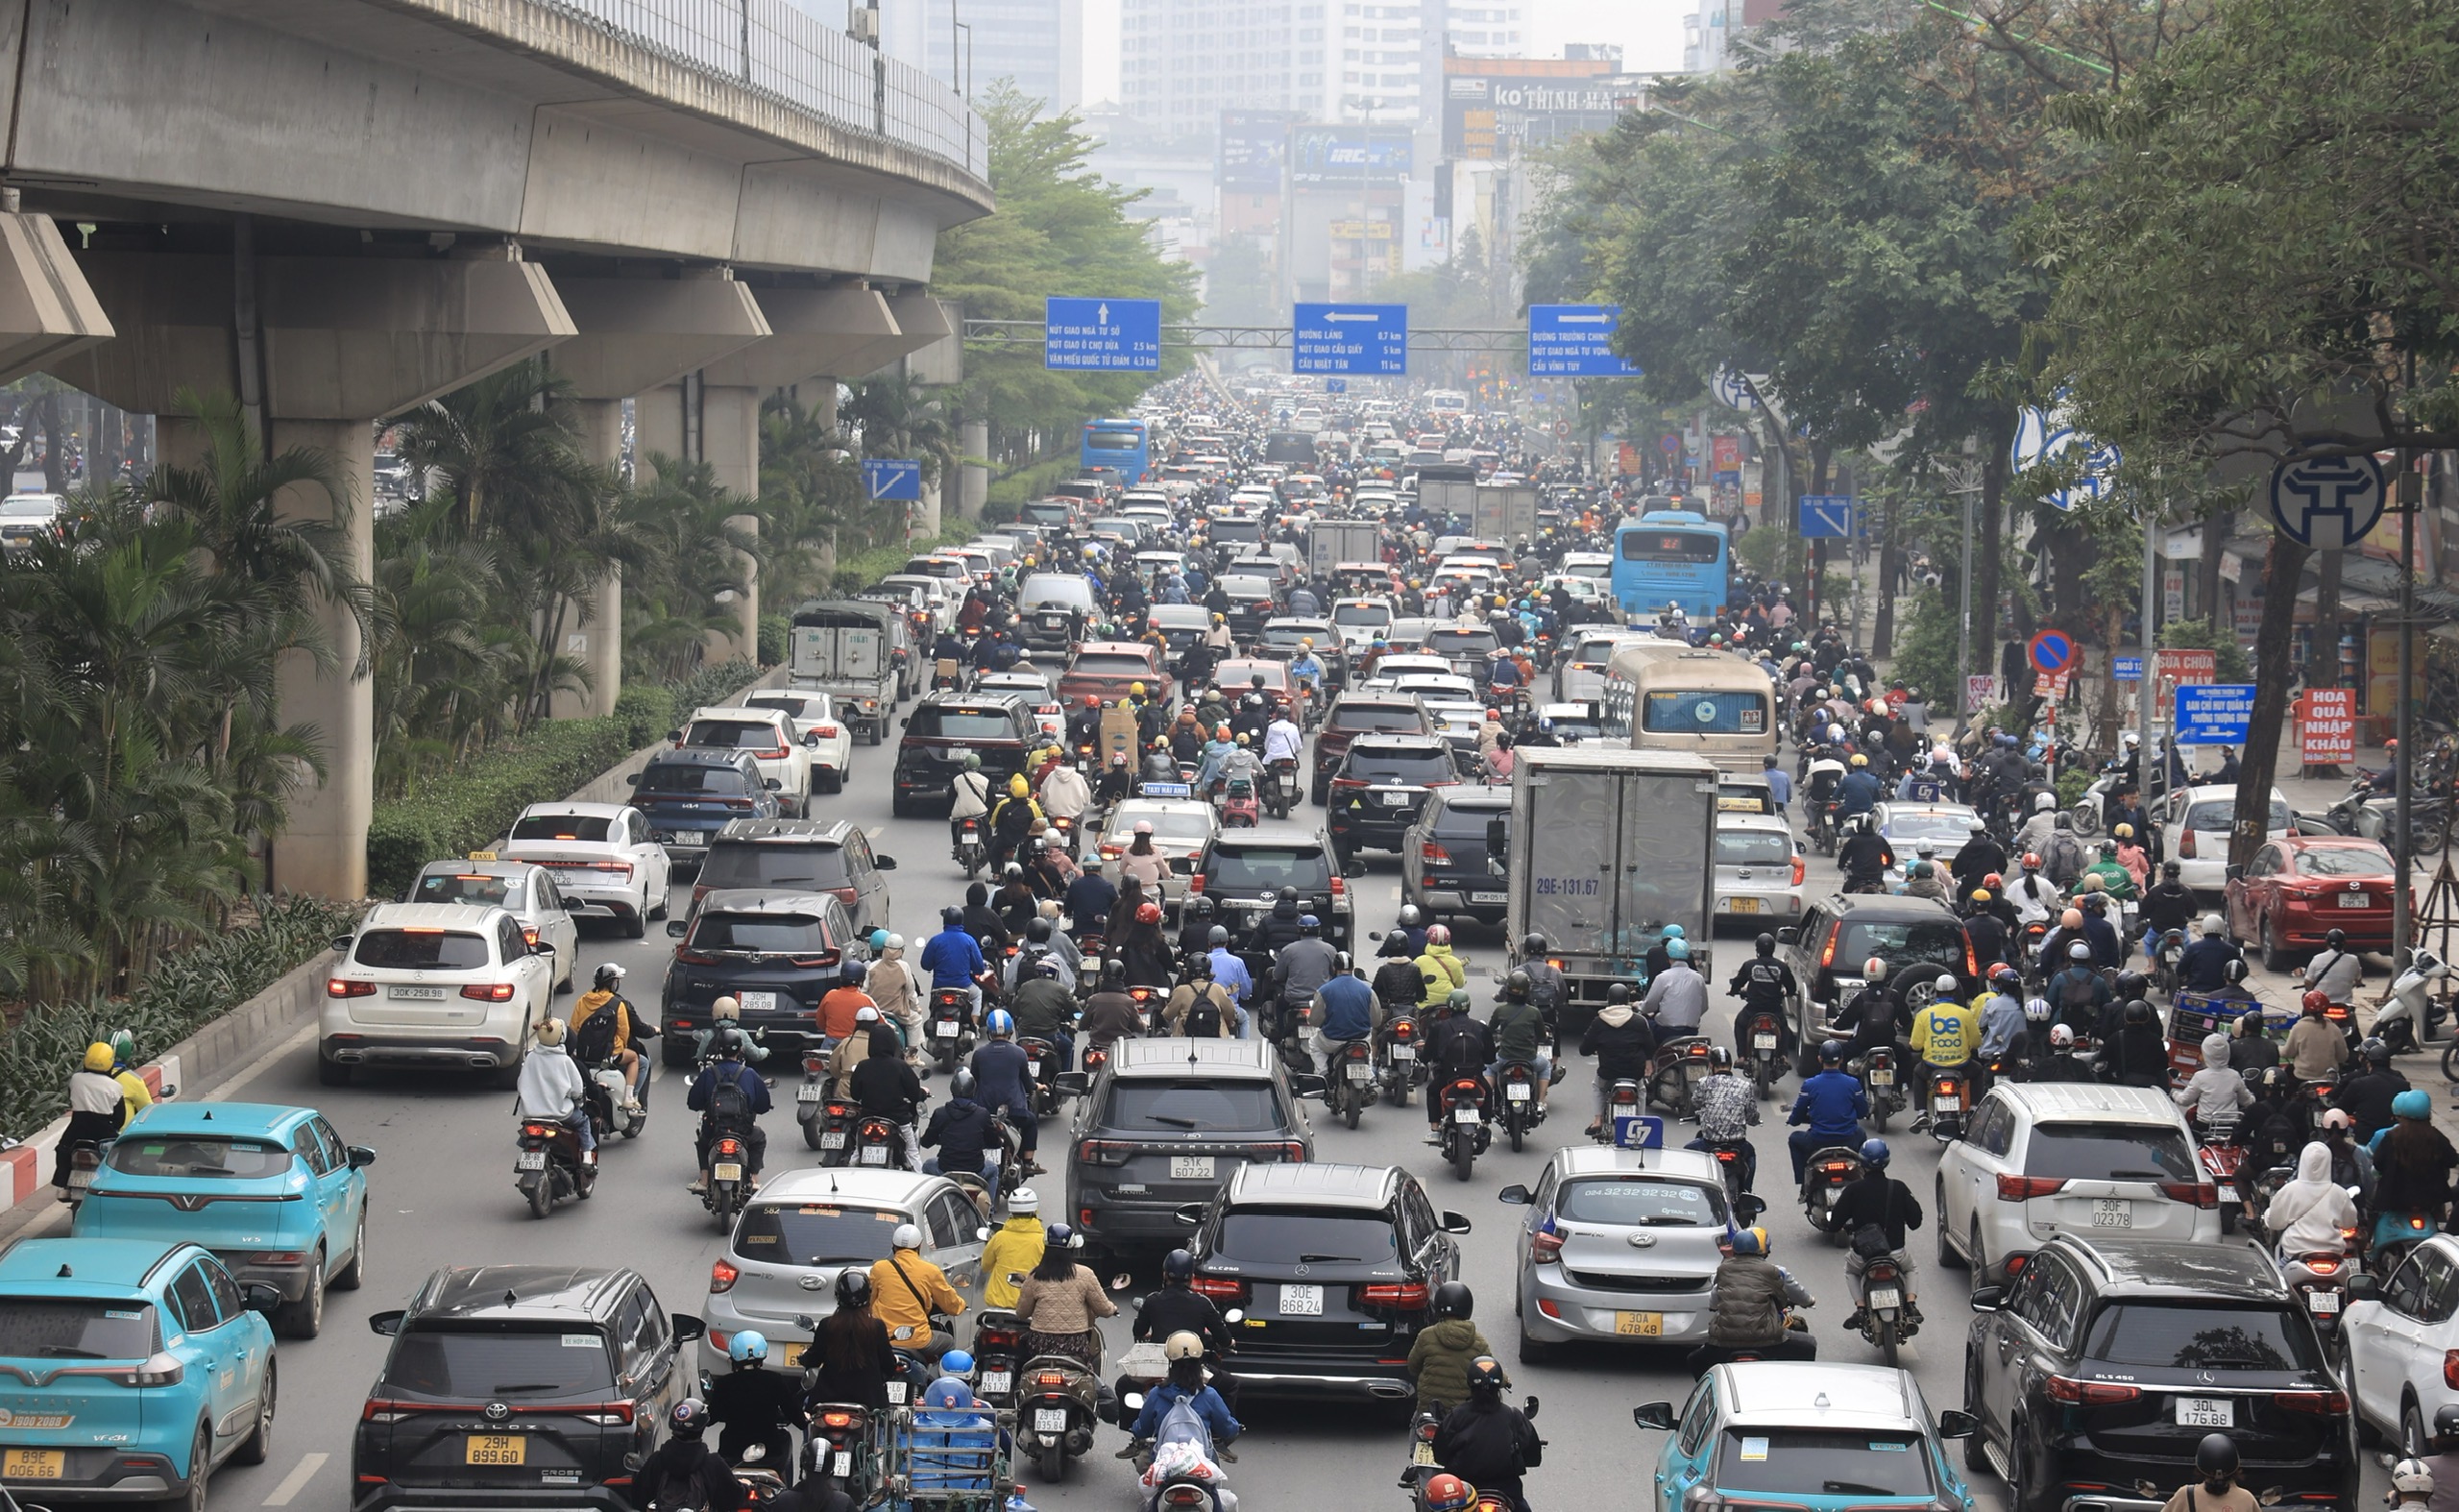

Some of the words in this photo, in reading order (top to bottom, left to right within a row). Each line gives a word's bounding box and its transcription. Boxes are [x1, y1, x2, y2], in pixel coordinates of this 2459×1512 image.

[1049, 325, 1062, 335] NÚT
[1064, 327, 1080, 335] GIAO
[1390, 331, 1401, 340] km
[1049, 338, 1062, 350] NÚT
[1064, 340, 1080, 350] GIAO
[1146, 342, 1157, 352] km
[1299, 342, 1313, 354] NÚT
[1314, 345, 1330, 354] GIAO
[1390, 346, 1401, 354] km
[1532, 345, 1546, 355] NÚT
[1547, 347, 1564, 355] GIAO
[1146, 356, 1157, 366] km
[1381, 359, 1388, 370] 11
[1390, 360, 1401, 370] km
[2158, 652, 2180, 670] SỬA
[2183, 654, 2214, 670] CHỮA
[2312, 692, 2347, 702] HOA
[2312, 703, 2347, 719] QUẢ
[1147, 786, 1160, 794] TAXI
[2101, 870, 2122, 879] Grab
[1536, 878, 1599, 896] 29E-131.67
[394, 988, 443, 997] 30K-258.98
[1930, 1012, 1961, 1036] be
[1931, 1036, 1962, 1048] Food
[1182, 1158, 1203, 1167] 51K
[1176, 1167, 1210, 1177] 607.22
[1622, 1188, 1641, 1197] 32
[1642, 1188, 1659, 1197] 32
[1660, 1189, 1678, 1198] 32
[764, 1207, 781, 1215] 582
[2101, 1200, 2122, 1212] 30F
[2094, 1213, 2130, 1227] 023.78
[1290, 1285, 1313, 1299] 30E
[1281, 1299, 1321, 1313] 868.24
[1629, 1313, 1649, 1324] 30A
[1620, 1323, 1657, 1334] 478.48
[983, 1381, 1009, 1392] 261.79
[2193, 1400, 2217, 1413] 30L
[1039, 1410, 1061, 1420] 29-E2
[2185, 1412, 2228, 1426] 176.88
[12, 1416, 37, 1427] 1900
[37, 1416, 62, 1427] 2088
[1036, 1421, 1063, 1431] 035.84
[483, 1437, 509, 1449] 29H
[21, 1451, 47, 1464] 89E
[473, 1450, 519, 1464] 899.60
[10, 1464, 56, 1477] 006.66
